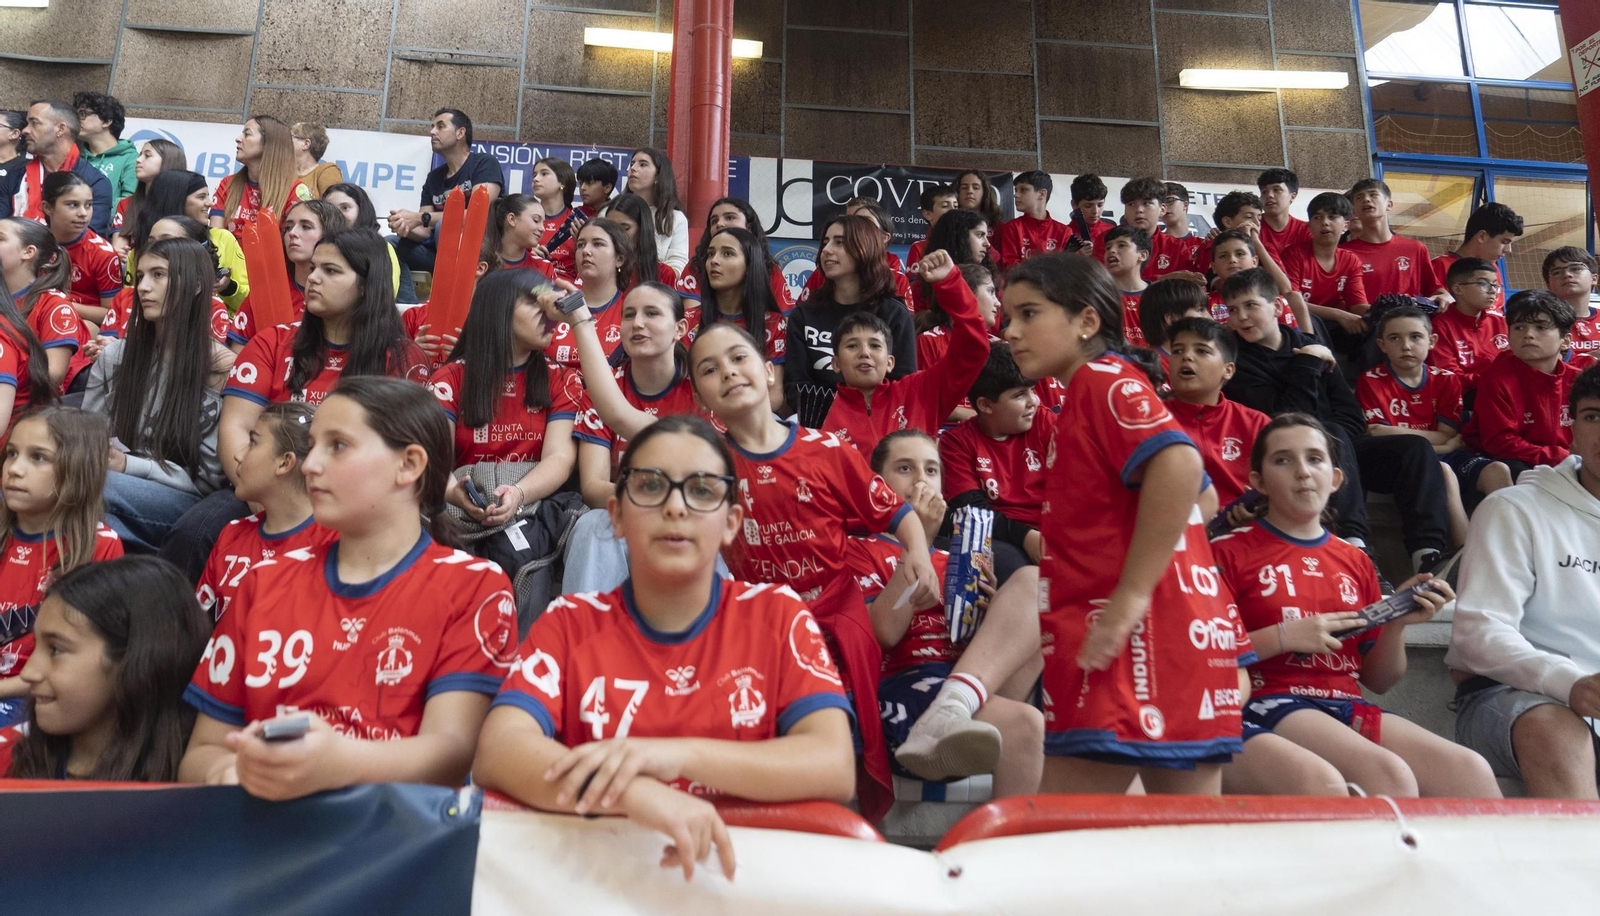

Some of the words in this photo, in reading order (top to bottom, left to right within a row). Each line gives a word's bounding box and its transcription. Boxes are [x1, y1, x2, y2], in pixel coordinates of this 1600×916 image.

[491, 423, 524, 433] XUNTA
[491, 433, 503, 442] DE
[505, 431, 542, 441] GALICIA
[774, 528, 817, 546] GALICIA
[218, 555, 252, 588] 72
[1258, 563, 1297, 597] 91
[910, 614, 946, 630] ZEN
[244, 629, 314, 689] 39
[579, 675, 650, 741] 47
